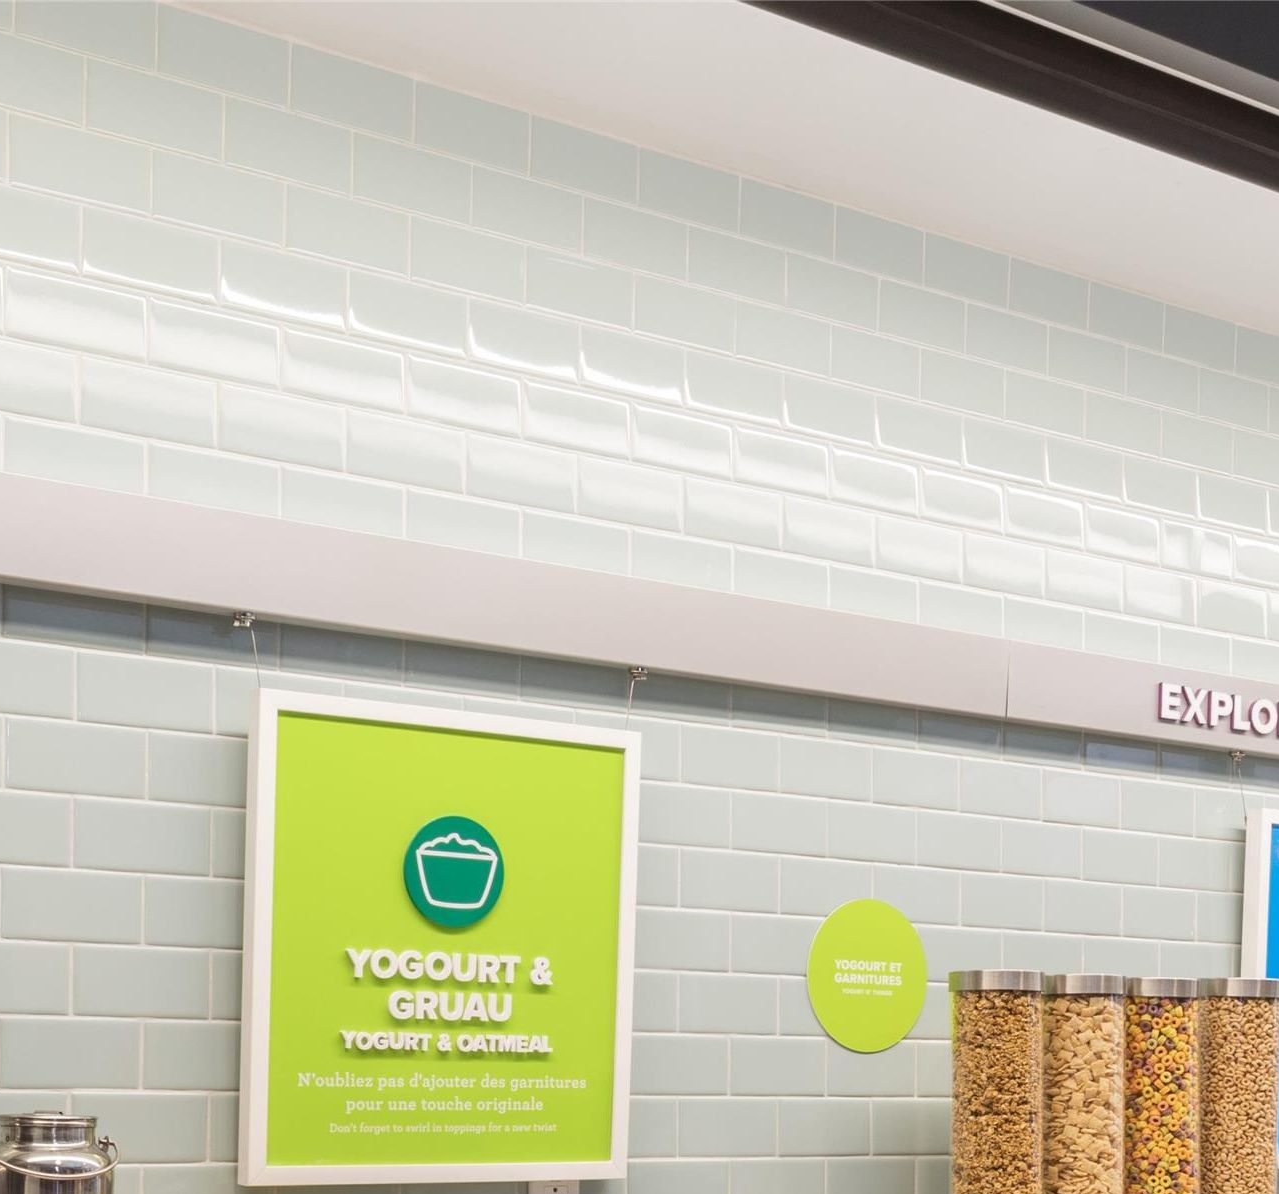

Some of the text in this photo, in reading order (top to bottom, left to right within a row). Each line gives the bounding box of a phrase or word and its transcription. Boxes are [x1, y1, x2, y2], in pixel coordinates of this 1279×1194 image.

[346, 948, 553, 985] YOGOURT &
[834, 959, 902, 973] YOGOURT ET
[834, 973, 902, 986] GARNITURES
[387, 989, 513, 1022] GRUAU
[339, 1030, 553, 1053] YOGURT & OATMEAL
[297, 1072, 587, 1091] N'oubliez pas d'ajouter des garnitures
[346, 1096, 544, 1114] pour une touche originale
[329, 1123, 357, 1133] Don't
[359, 1122, 390, 1135] forget
[393, 1124, 404, 1133] to
[405, 1122, 430, 1133] swirl
[432, 1123, 442, 1133] in
[444, 1123, 486, 1135] toppings
[488, 1122, 502, 1132] for
[533, 1123, 557, 1132] twist
